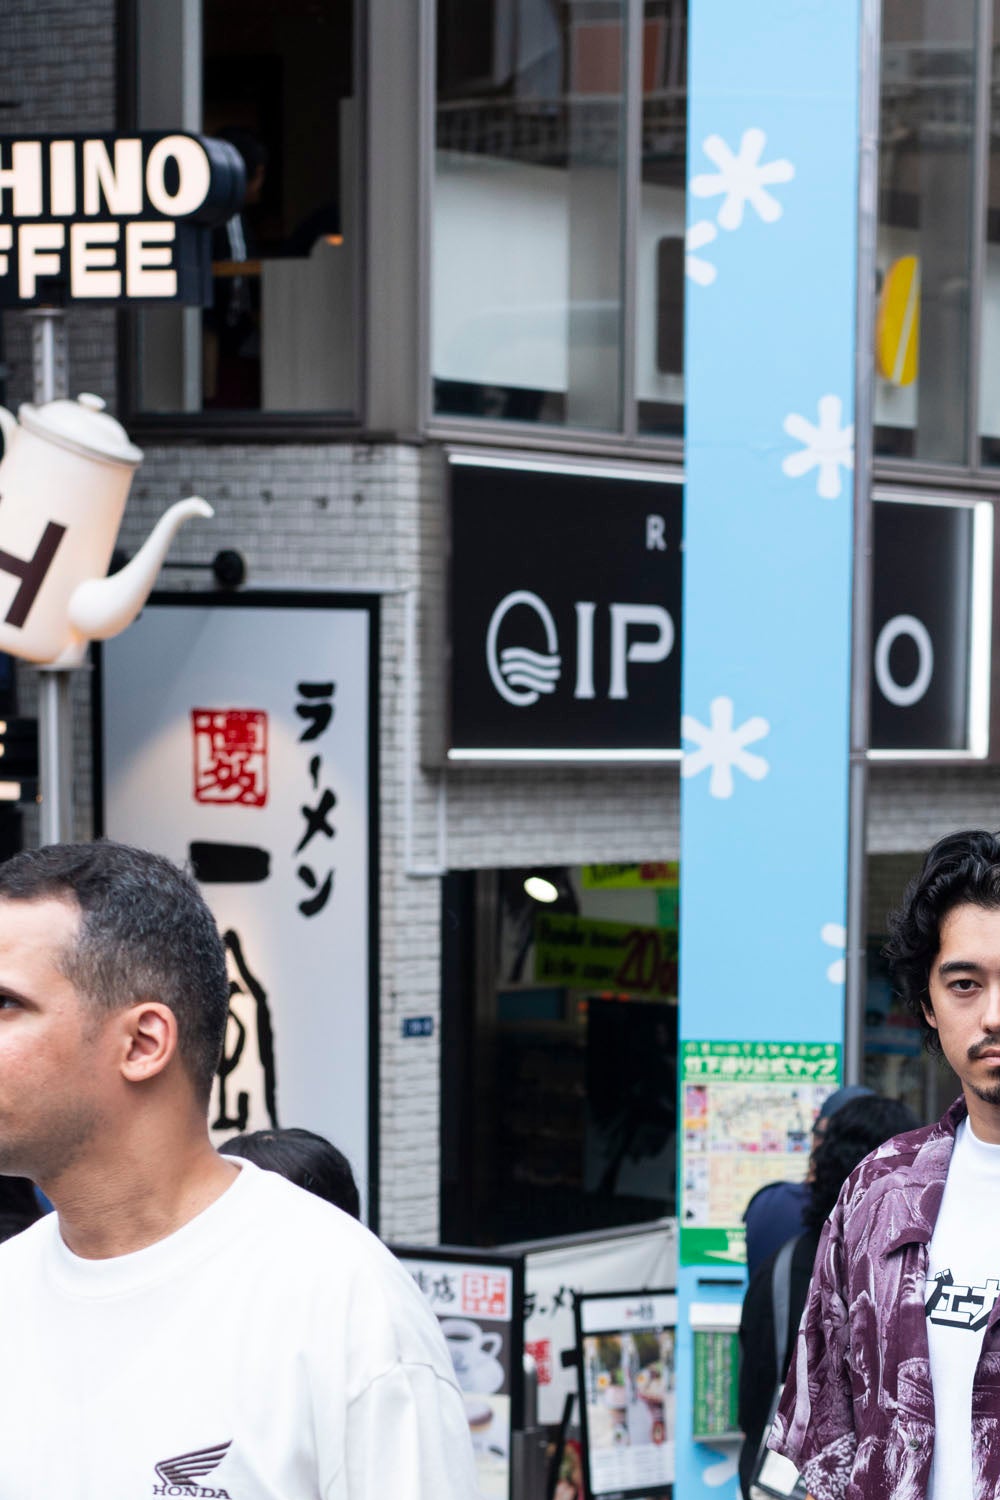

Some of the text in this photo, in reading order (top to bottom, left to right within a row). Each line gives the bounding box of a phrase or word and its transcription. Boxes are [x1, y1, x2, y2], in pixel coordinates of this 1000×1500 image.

[0, 221, 178, 299] FEE
[295, 682, 337, 917] ラーメン
[152, 1484, 233, 1500] HONDA
